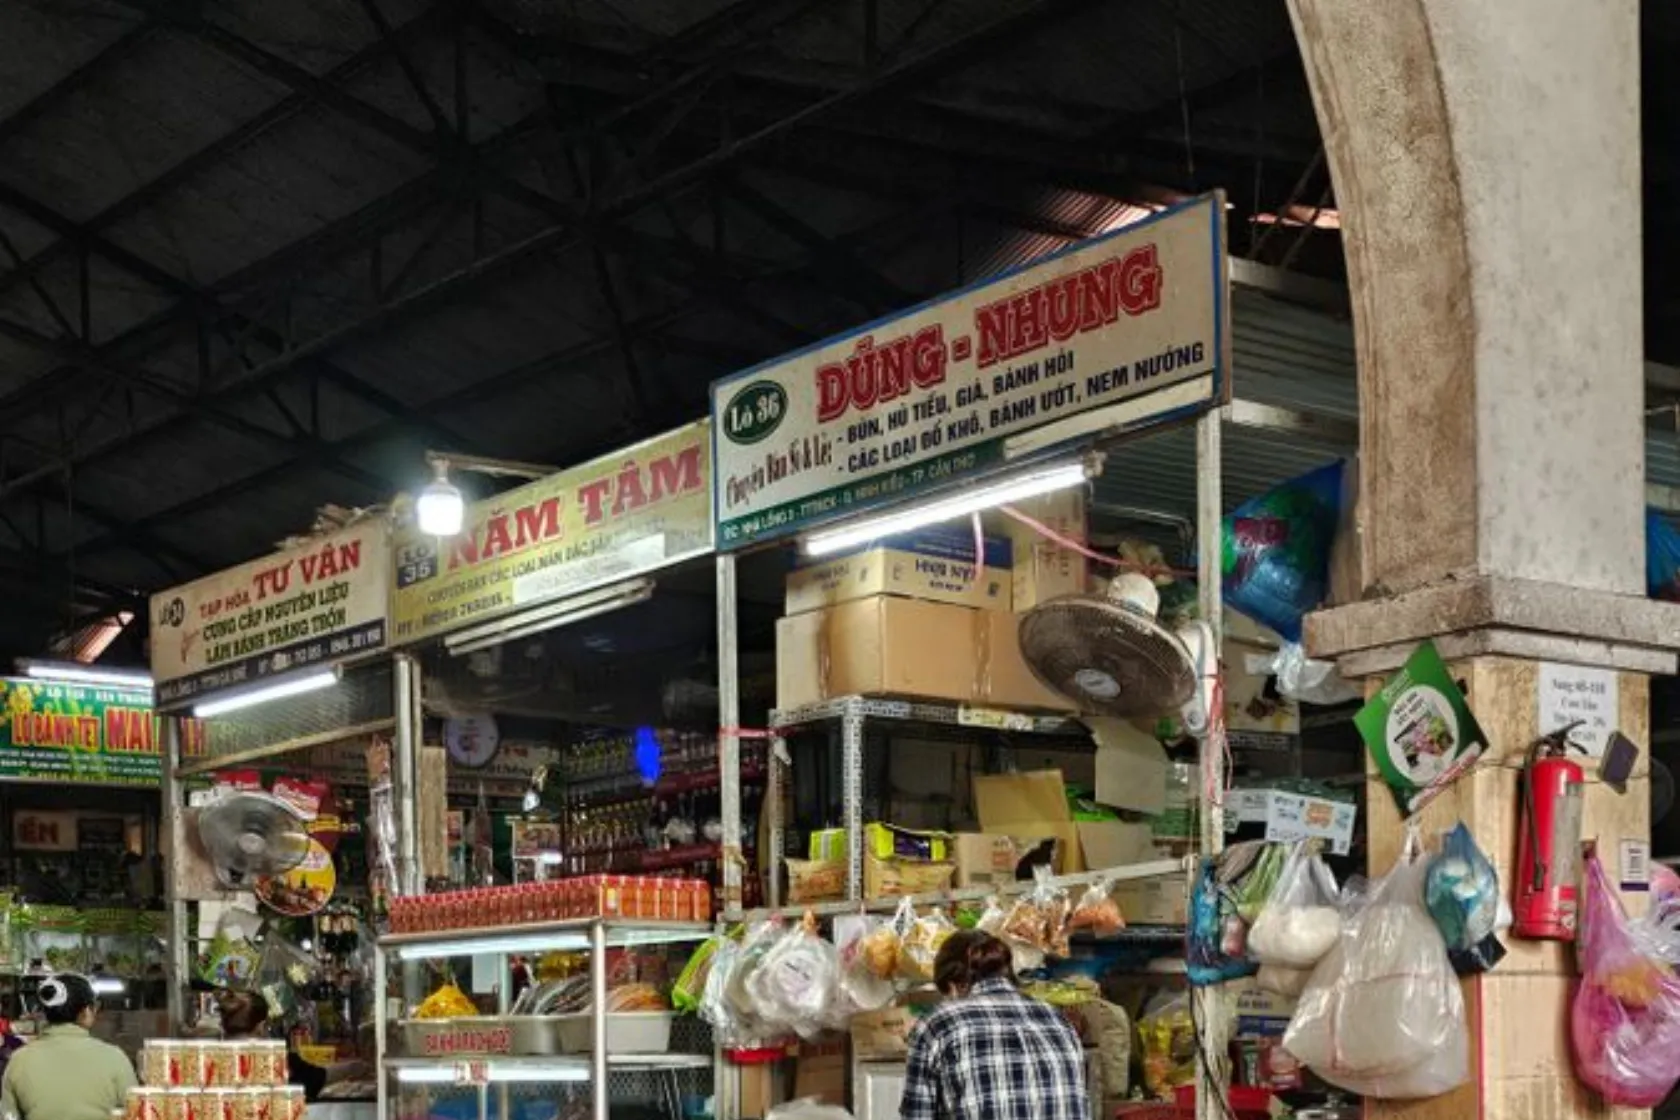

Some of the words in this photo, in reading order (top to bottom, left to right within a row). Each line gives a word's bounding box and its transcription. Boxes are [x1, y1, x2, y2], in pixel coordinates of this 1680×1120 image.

[816, 322, 946, 423] DŨNG
[975, 243, 1163, 369] NHUNG
[1087, 365, 1129, 398] NEM
[1135, 342, 1204, 381] NƯỚNG
[756, 391, 781, 424] 36
[578, 444, 705, 525] TÂM
[253, 559, 294, 600] TƯ
[299, 539, 362, 585] VÂN
